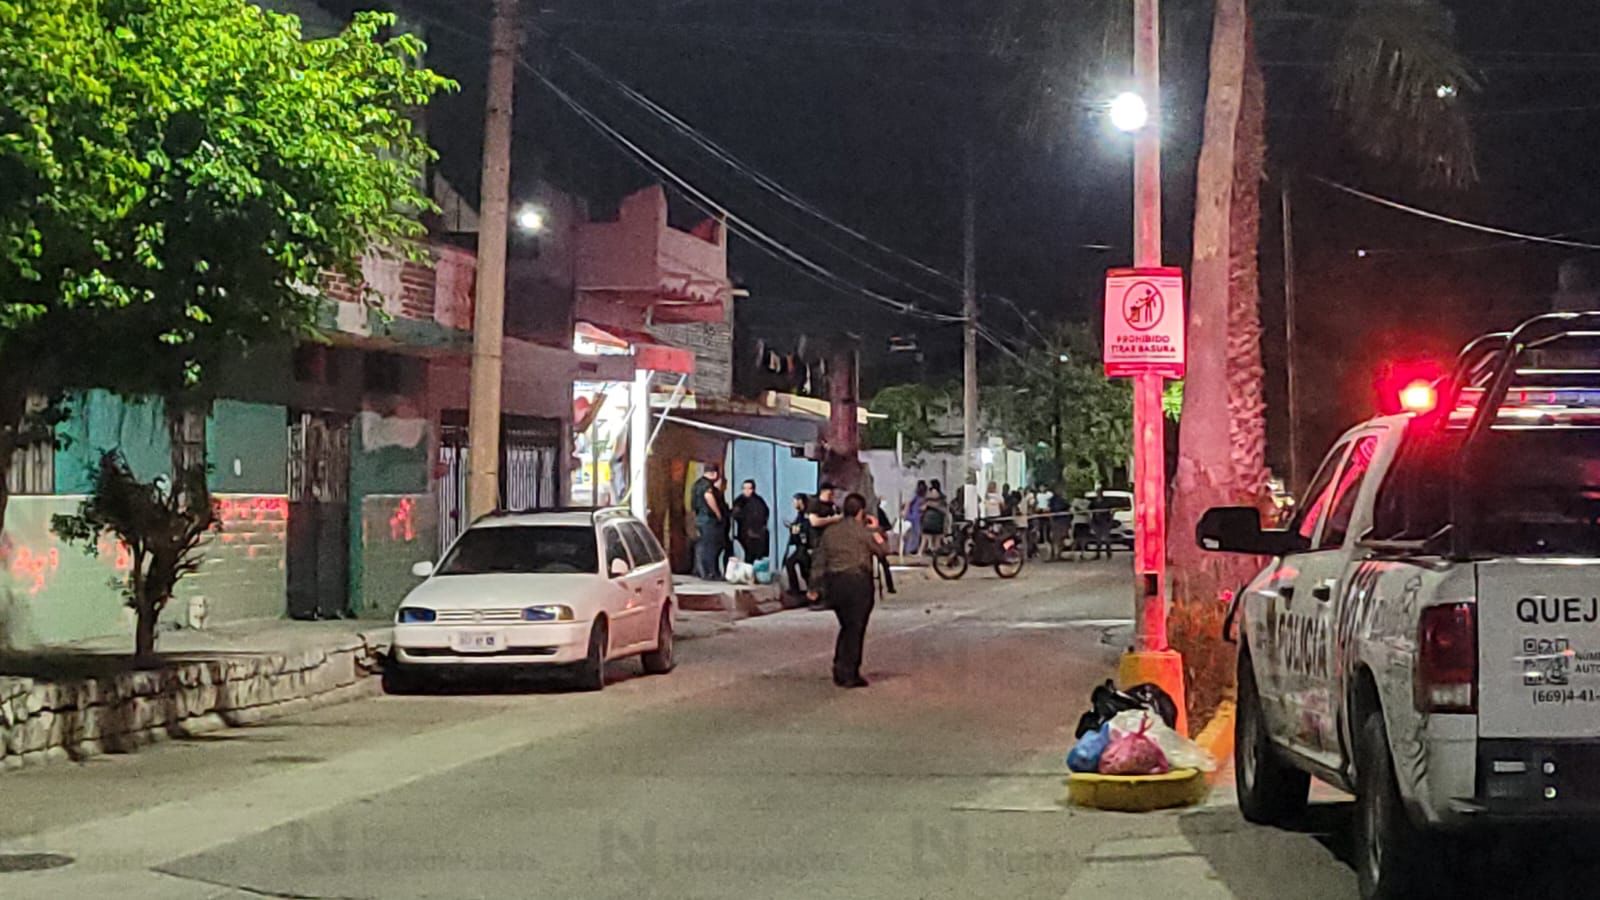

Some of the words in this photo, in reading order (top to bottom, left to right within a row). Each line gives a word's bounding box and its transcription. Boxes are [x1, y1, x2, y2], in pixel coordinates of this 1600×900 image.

[1116, 335, 1170, 343] PROHIBIDO
[1111, 344, 1136, 353] TIRAR
[1138, 344, 1176, 353] BASURA
[1516, 597, 1599, 624] QUEJ
